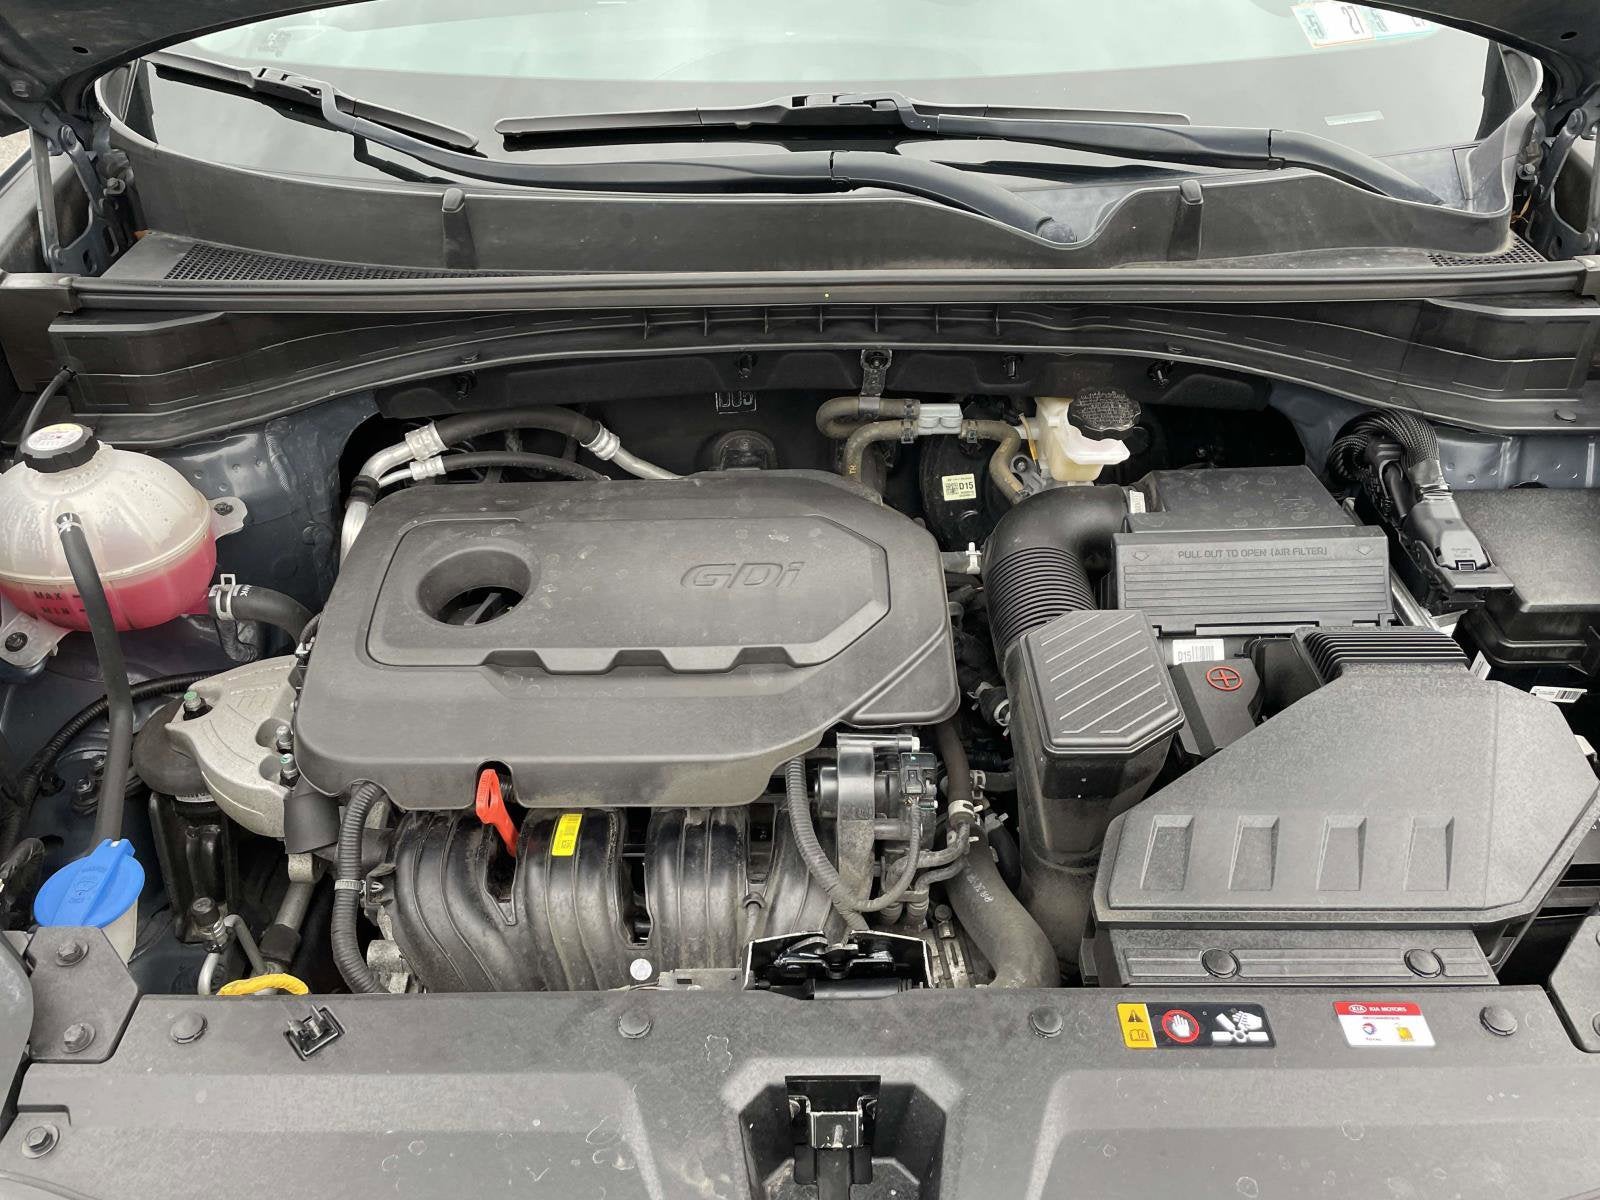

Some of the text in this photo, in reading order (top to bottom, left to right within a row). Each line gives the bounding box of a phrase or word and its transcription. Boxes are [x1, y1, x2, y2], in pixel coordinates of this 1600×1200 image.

[958, 482, 974, 490] D15
[1178, 550, 1202, 559] PULL
[1204, 549, 1223, 558] OUT
[1226, 549, 1239, 558] TO
[1240, 548, 1266, 557] OPEN
[680, 561, 805, 589] GDi
[34, 591, 63, 600] MAX
[42, 606, 70, 615] MIN
